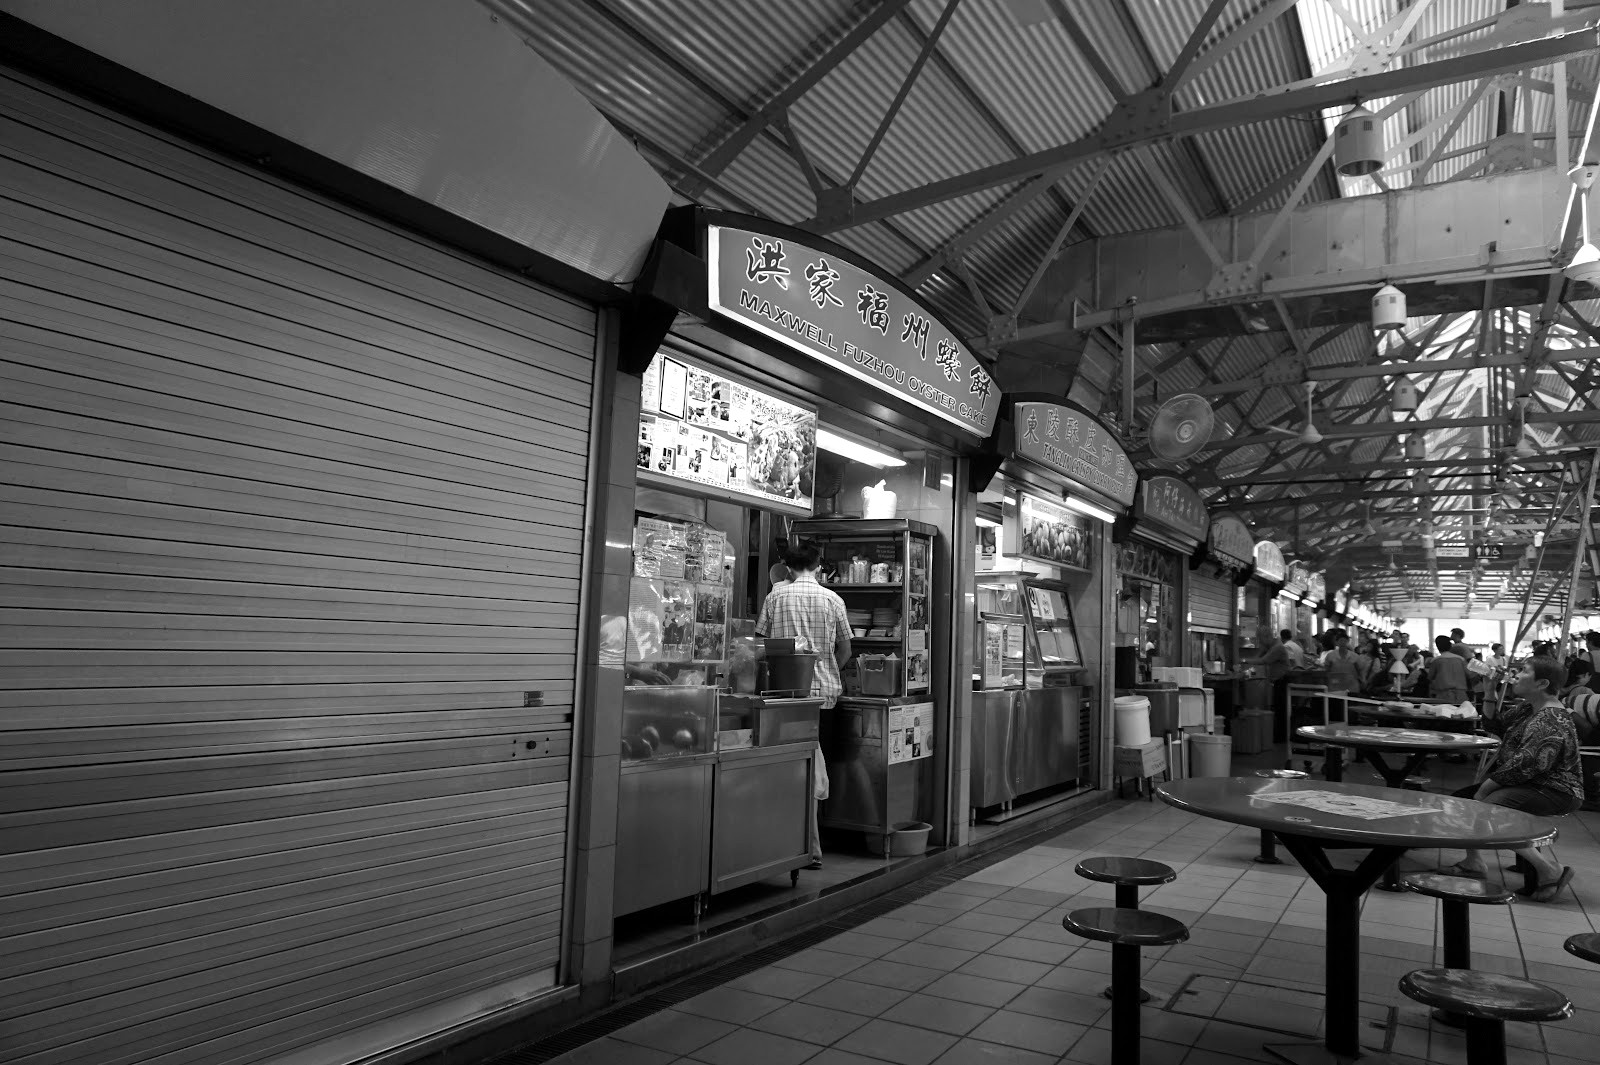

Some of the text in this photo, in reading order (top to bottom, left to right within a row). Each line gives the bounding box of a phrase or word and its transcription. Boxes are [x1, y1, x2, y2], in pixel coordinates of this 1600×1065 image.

[739, 288, 988, 427] MAXWELL FUZHOU OYSTER CAKE
[1042, 441, 1072, 471] TANGLIN
[1071, 457, 1094, 482] CRISPY
